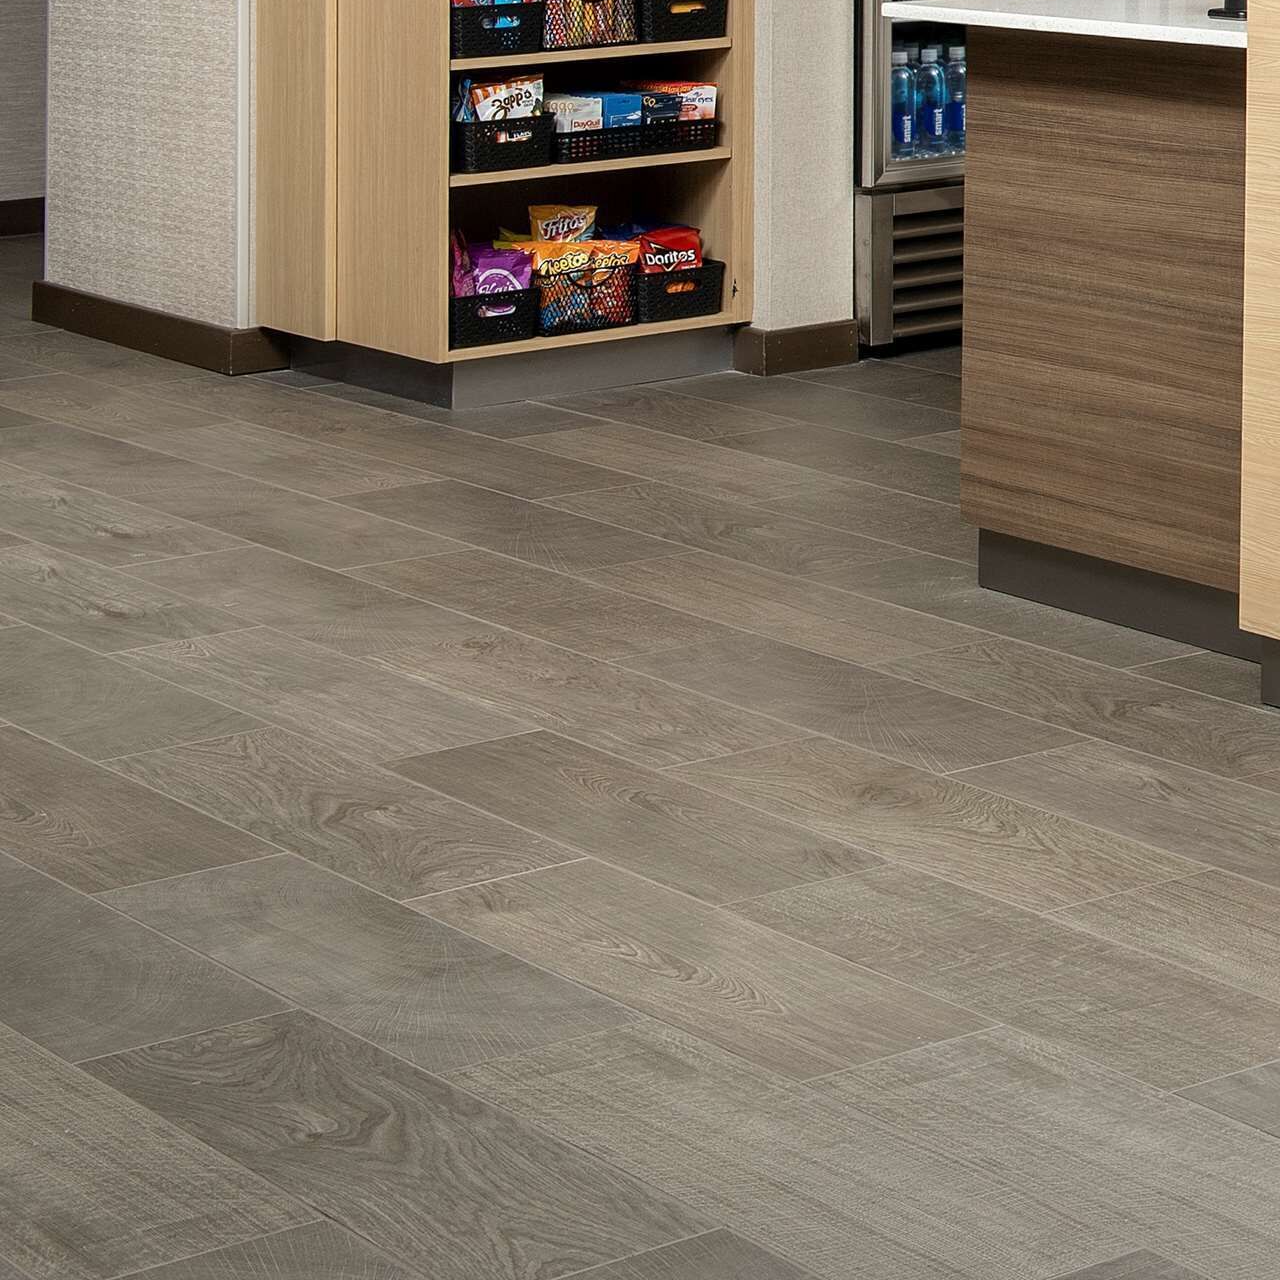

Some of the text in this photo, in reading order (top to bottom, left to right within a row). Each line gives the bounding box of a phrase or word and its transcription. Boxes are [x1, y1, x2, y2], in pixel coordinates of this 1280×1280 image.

[902, 114, 912, 143] smart
[933, 108, 943, 136] smart
[645, 249, 696, 265] Doritos
